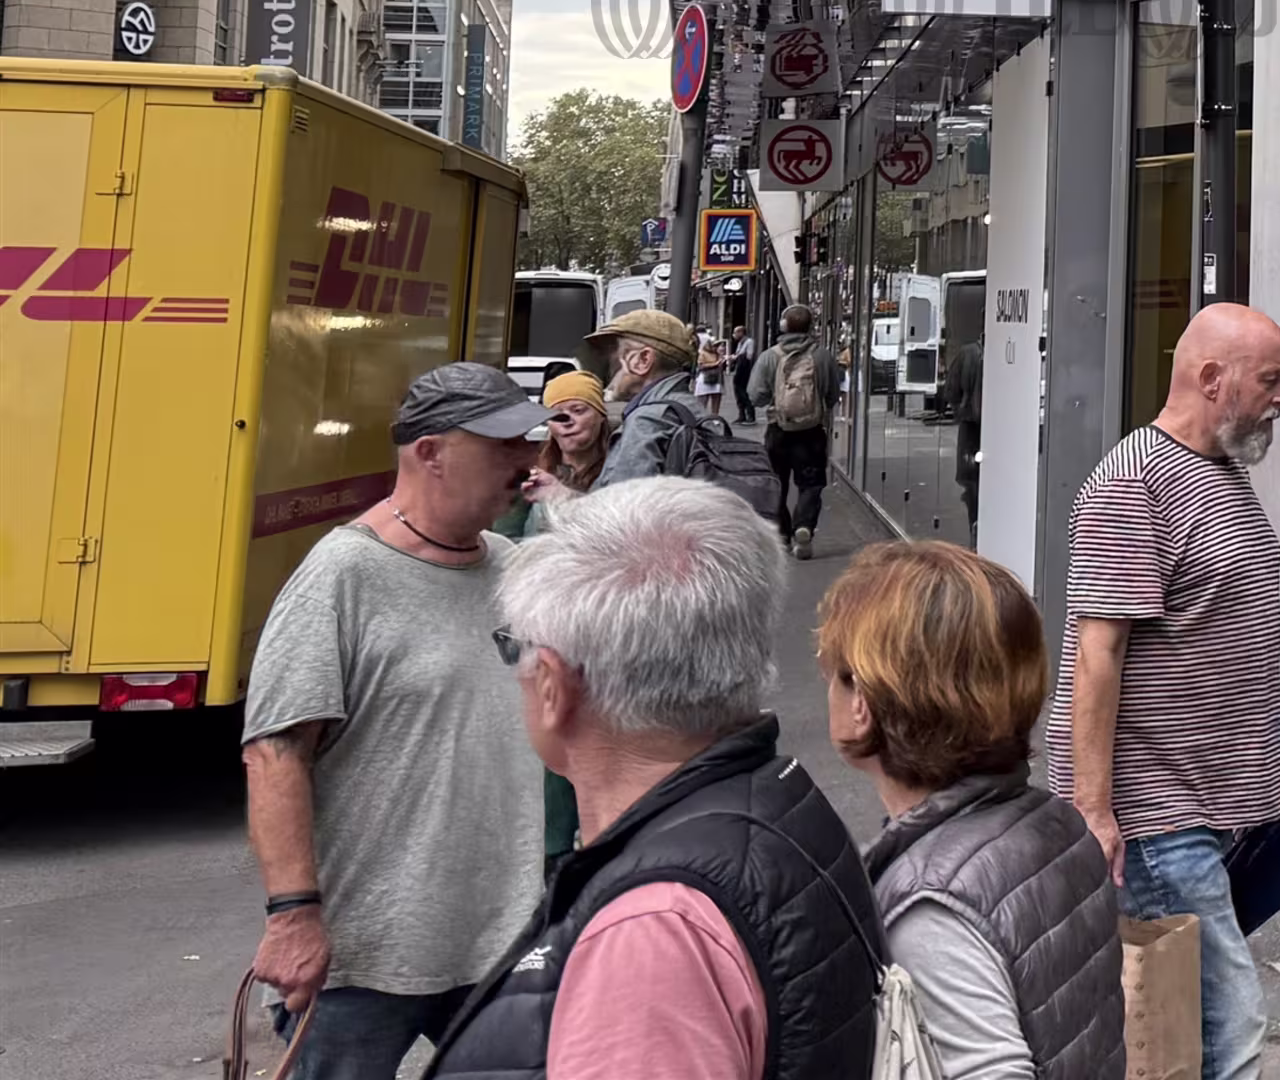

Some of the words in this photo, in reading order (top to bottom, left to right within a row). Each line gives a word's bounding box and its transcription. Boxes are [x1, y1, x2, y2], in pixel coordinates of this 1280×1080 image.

[465, 52, 483, 139] PRIMARK
[312, 186, 433, 317] DHL
[709, 243, 746, 255] ALDI
